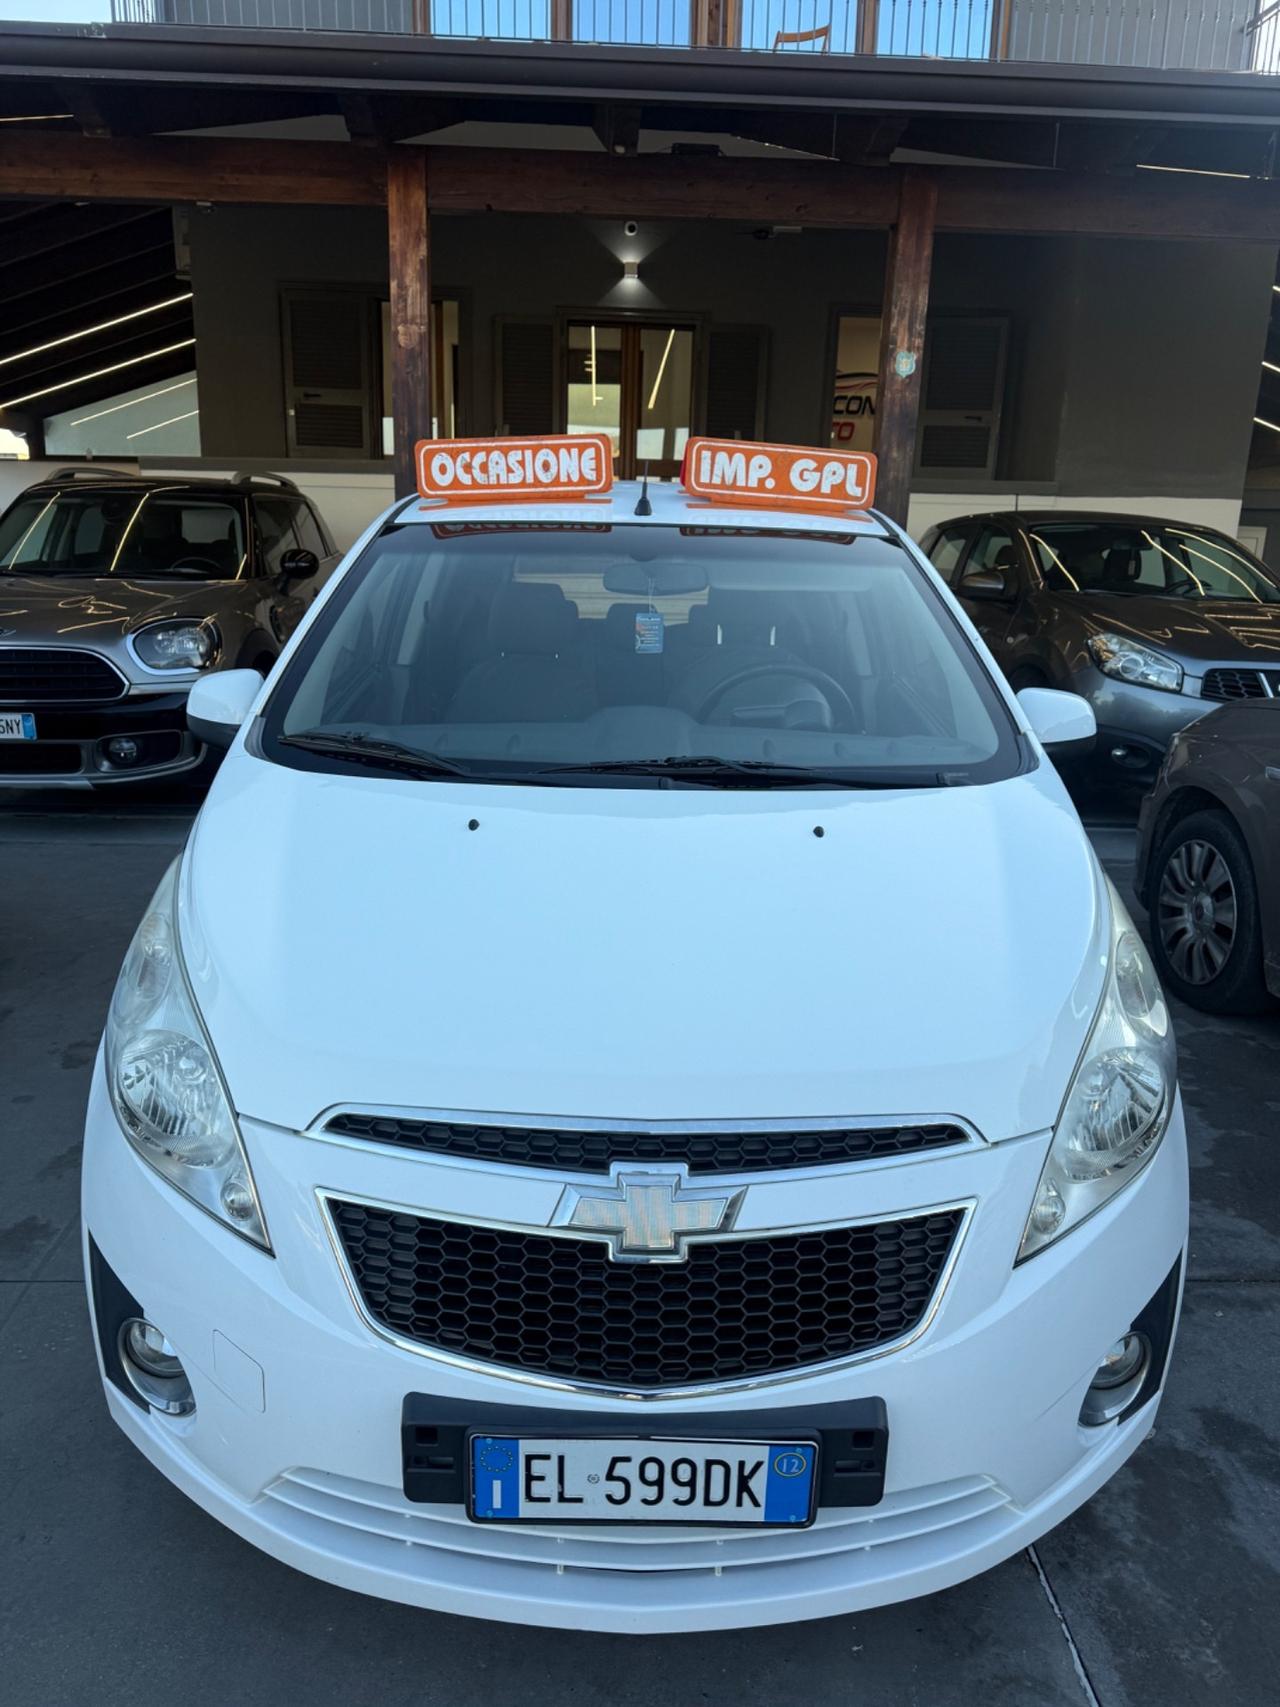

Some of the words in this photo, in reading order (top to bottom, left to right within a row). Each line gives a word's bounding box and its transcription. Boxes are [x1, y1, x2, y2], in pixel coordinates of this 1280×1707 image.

[431, 447, 597, 487] OCCASIONE
[700, 450, 775, 489] IMP.
[790, 459, 863, 497] GPL
[524, 1454, 584, 1503] EL
[605, 1456, 765, 1508] 599DK
[780, 1458, 801, 1474] 12
[492, 1479, 502, 1509] I
